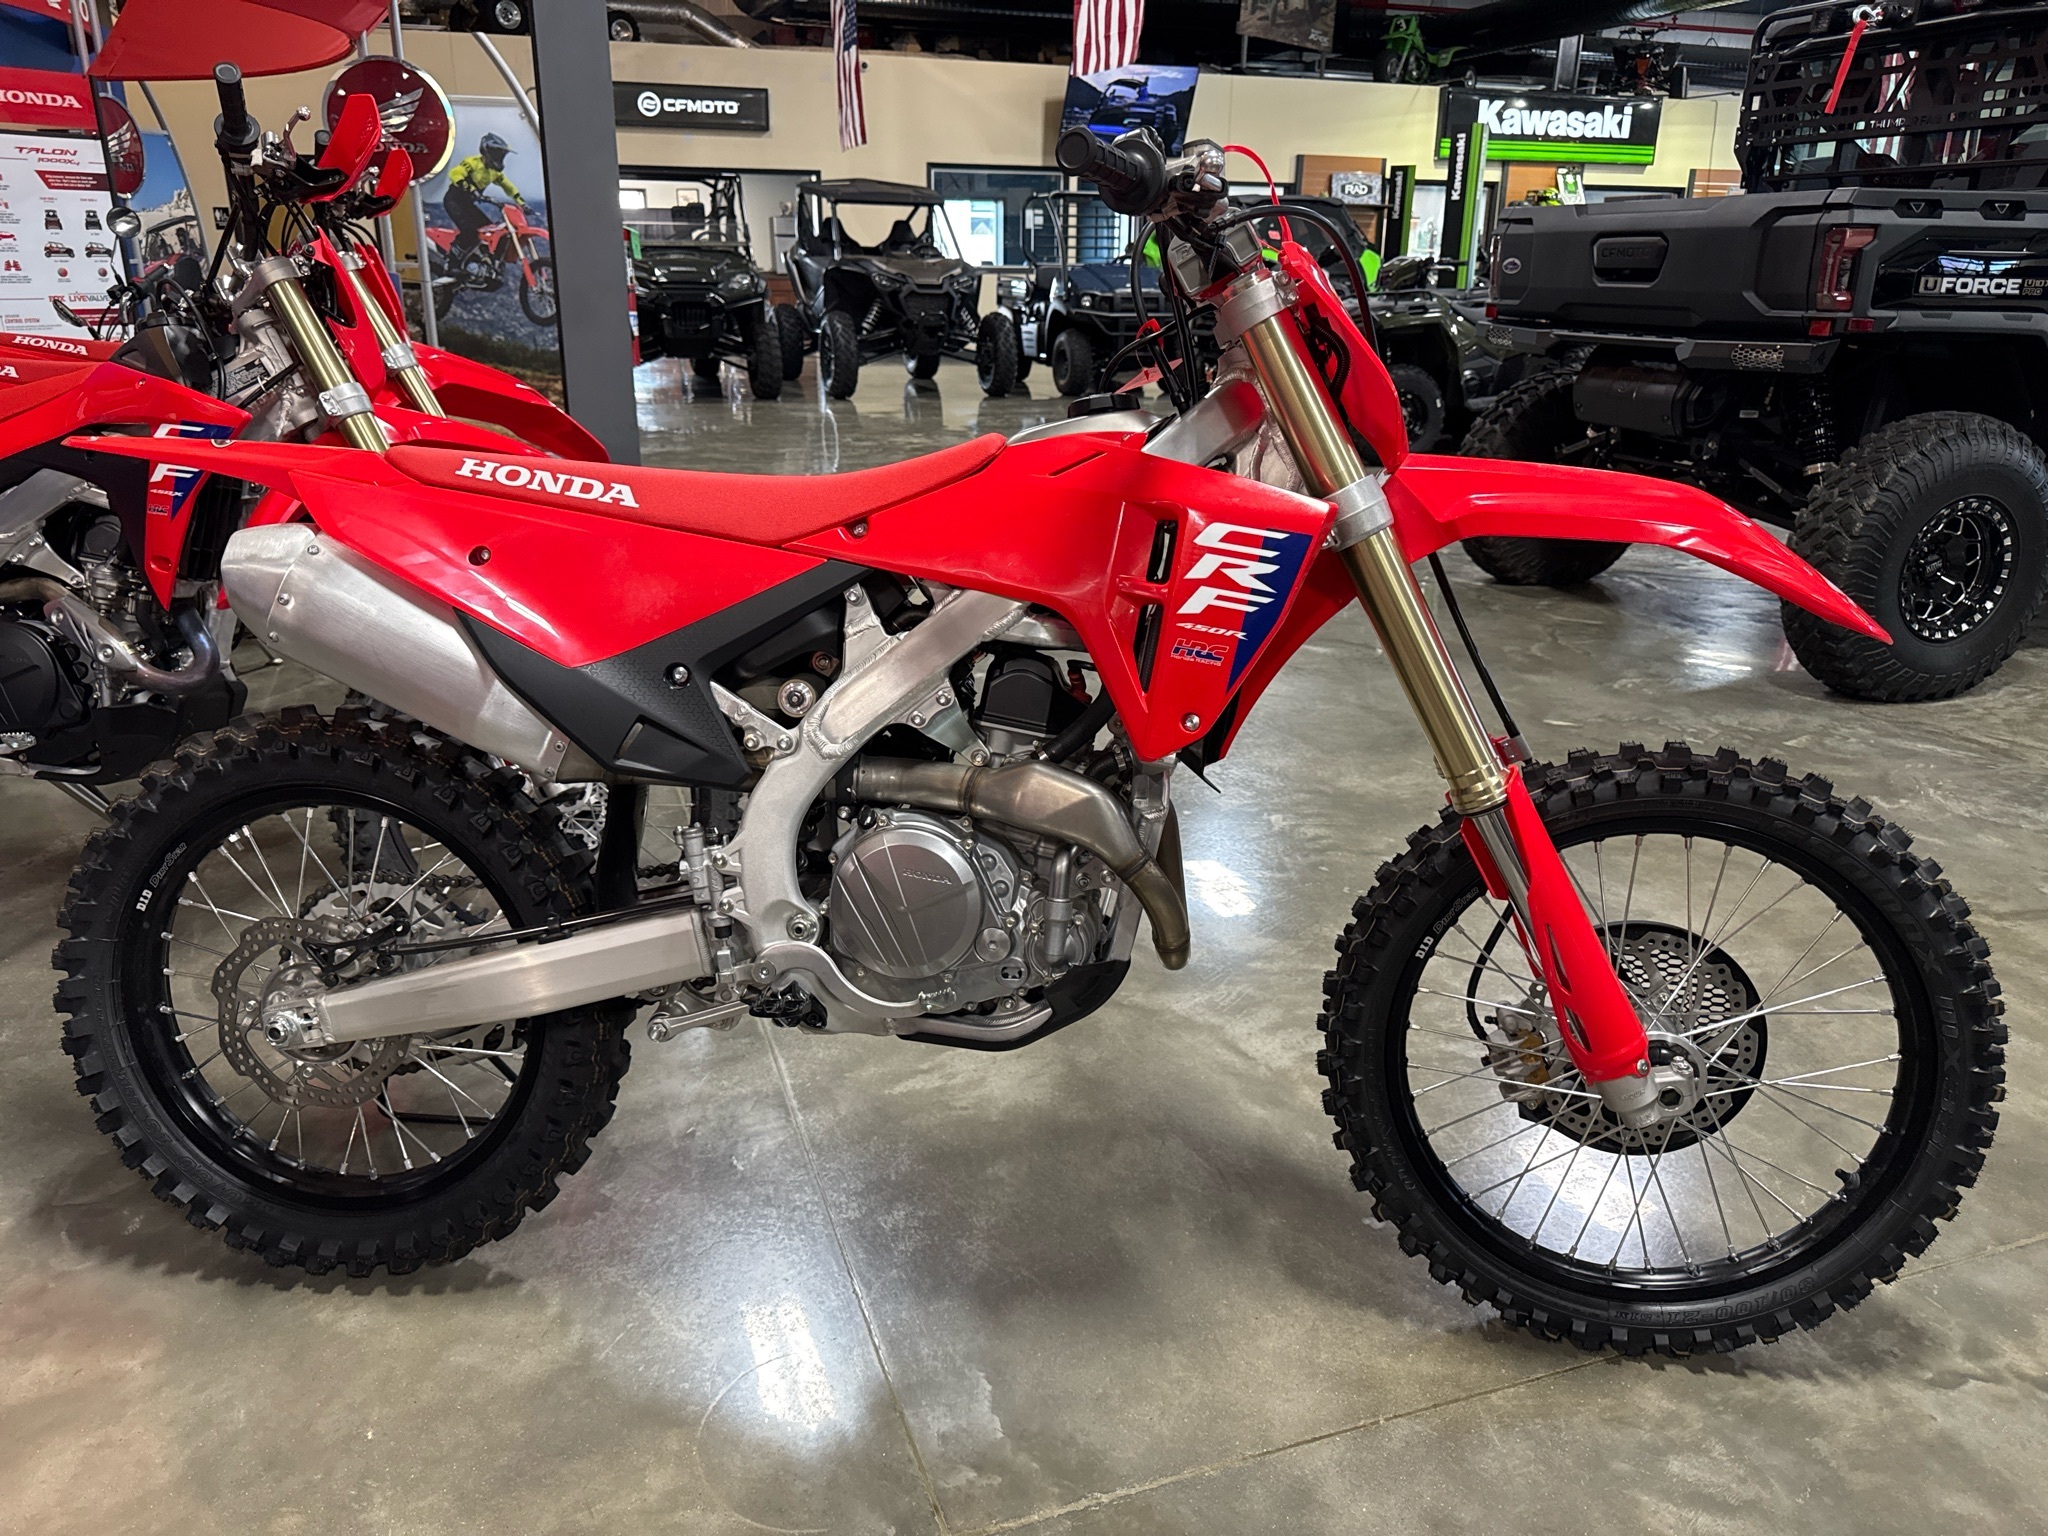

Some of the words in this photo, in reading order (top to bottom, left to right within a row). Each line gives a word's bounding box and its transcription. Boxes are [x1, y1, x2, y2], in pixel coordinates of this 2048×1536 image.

[663, 98, 740, 115] CFMOTO
[1477, 99, 1633, 139] Kawasaki
[14, 146, 78, 156] TALON
[1450, 133, 1467, 201] Kawasaki
[1344, 185, 1369, 195] RAD
[1391, 170, 1404, 220] Kawasaki
[2021, 287, 2043, 296] PRO
[12, 335, 88, 356] HONDA
[454, 457, 640, 509] HONDA
[1175, 521, 1291, 615] CRF
[1175, 622, 1249, 641] 450R
[1171, 637, 1230, 662] HRC
[902, 868, 953, 885] HONDA
